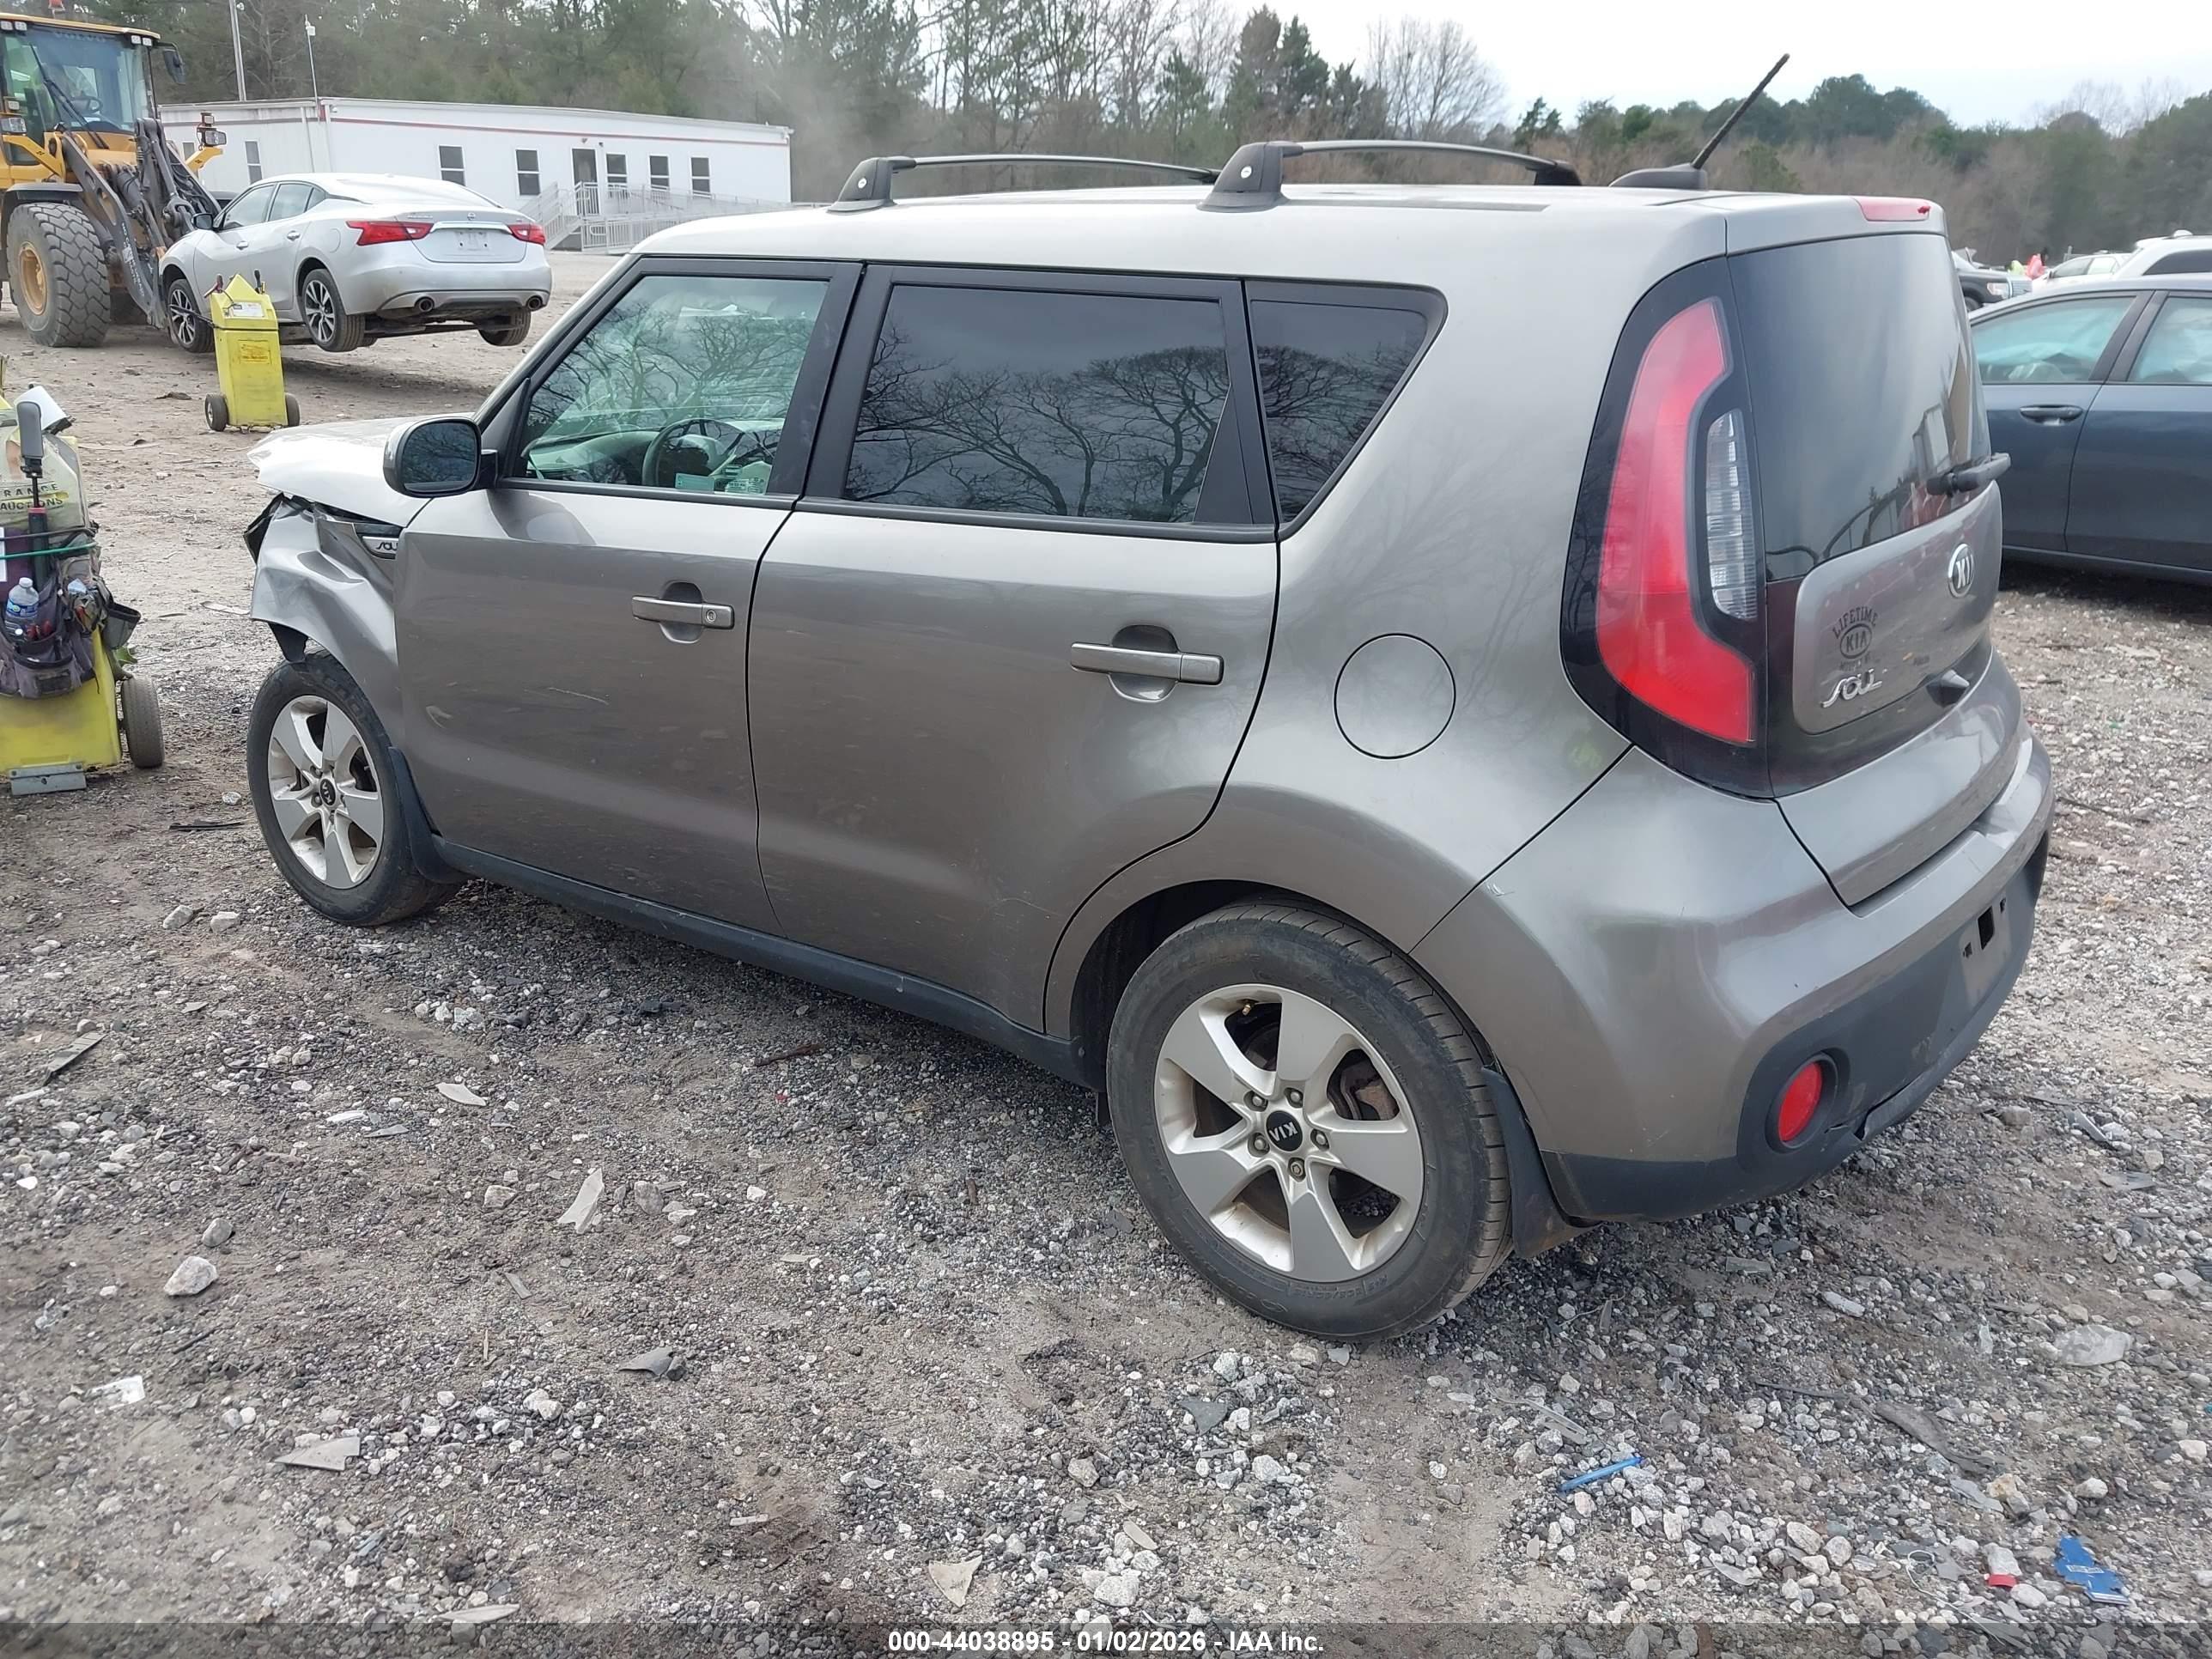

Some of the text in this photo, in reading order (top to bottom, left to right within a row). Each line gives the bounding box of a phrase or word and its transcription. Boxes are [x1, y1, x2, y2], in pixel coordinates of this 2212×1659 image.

[0, 498, 64, 510] AUCTONS
[1832, 606, 1878, 639] LIFETIME
[1846, 630, 1867, 653] KIA
[1820, 668, 1882, 708] SOUL
[1268, 1121, 1298, 1141] KIA
